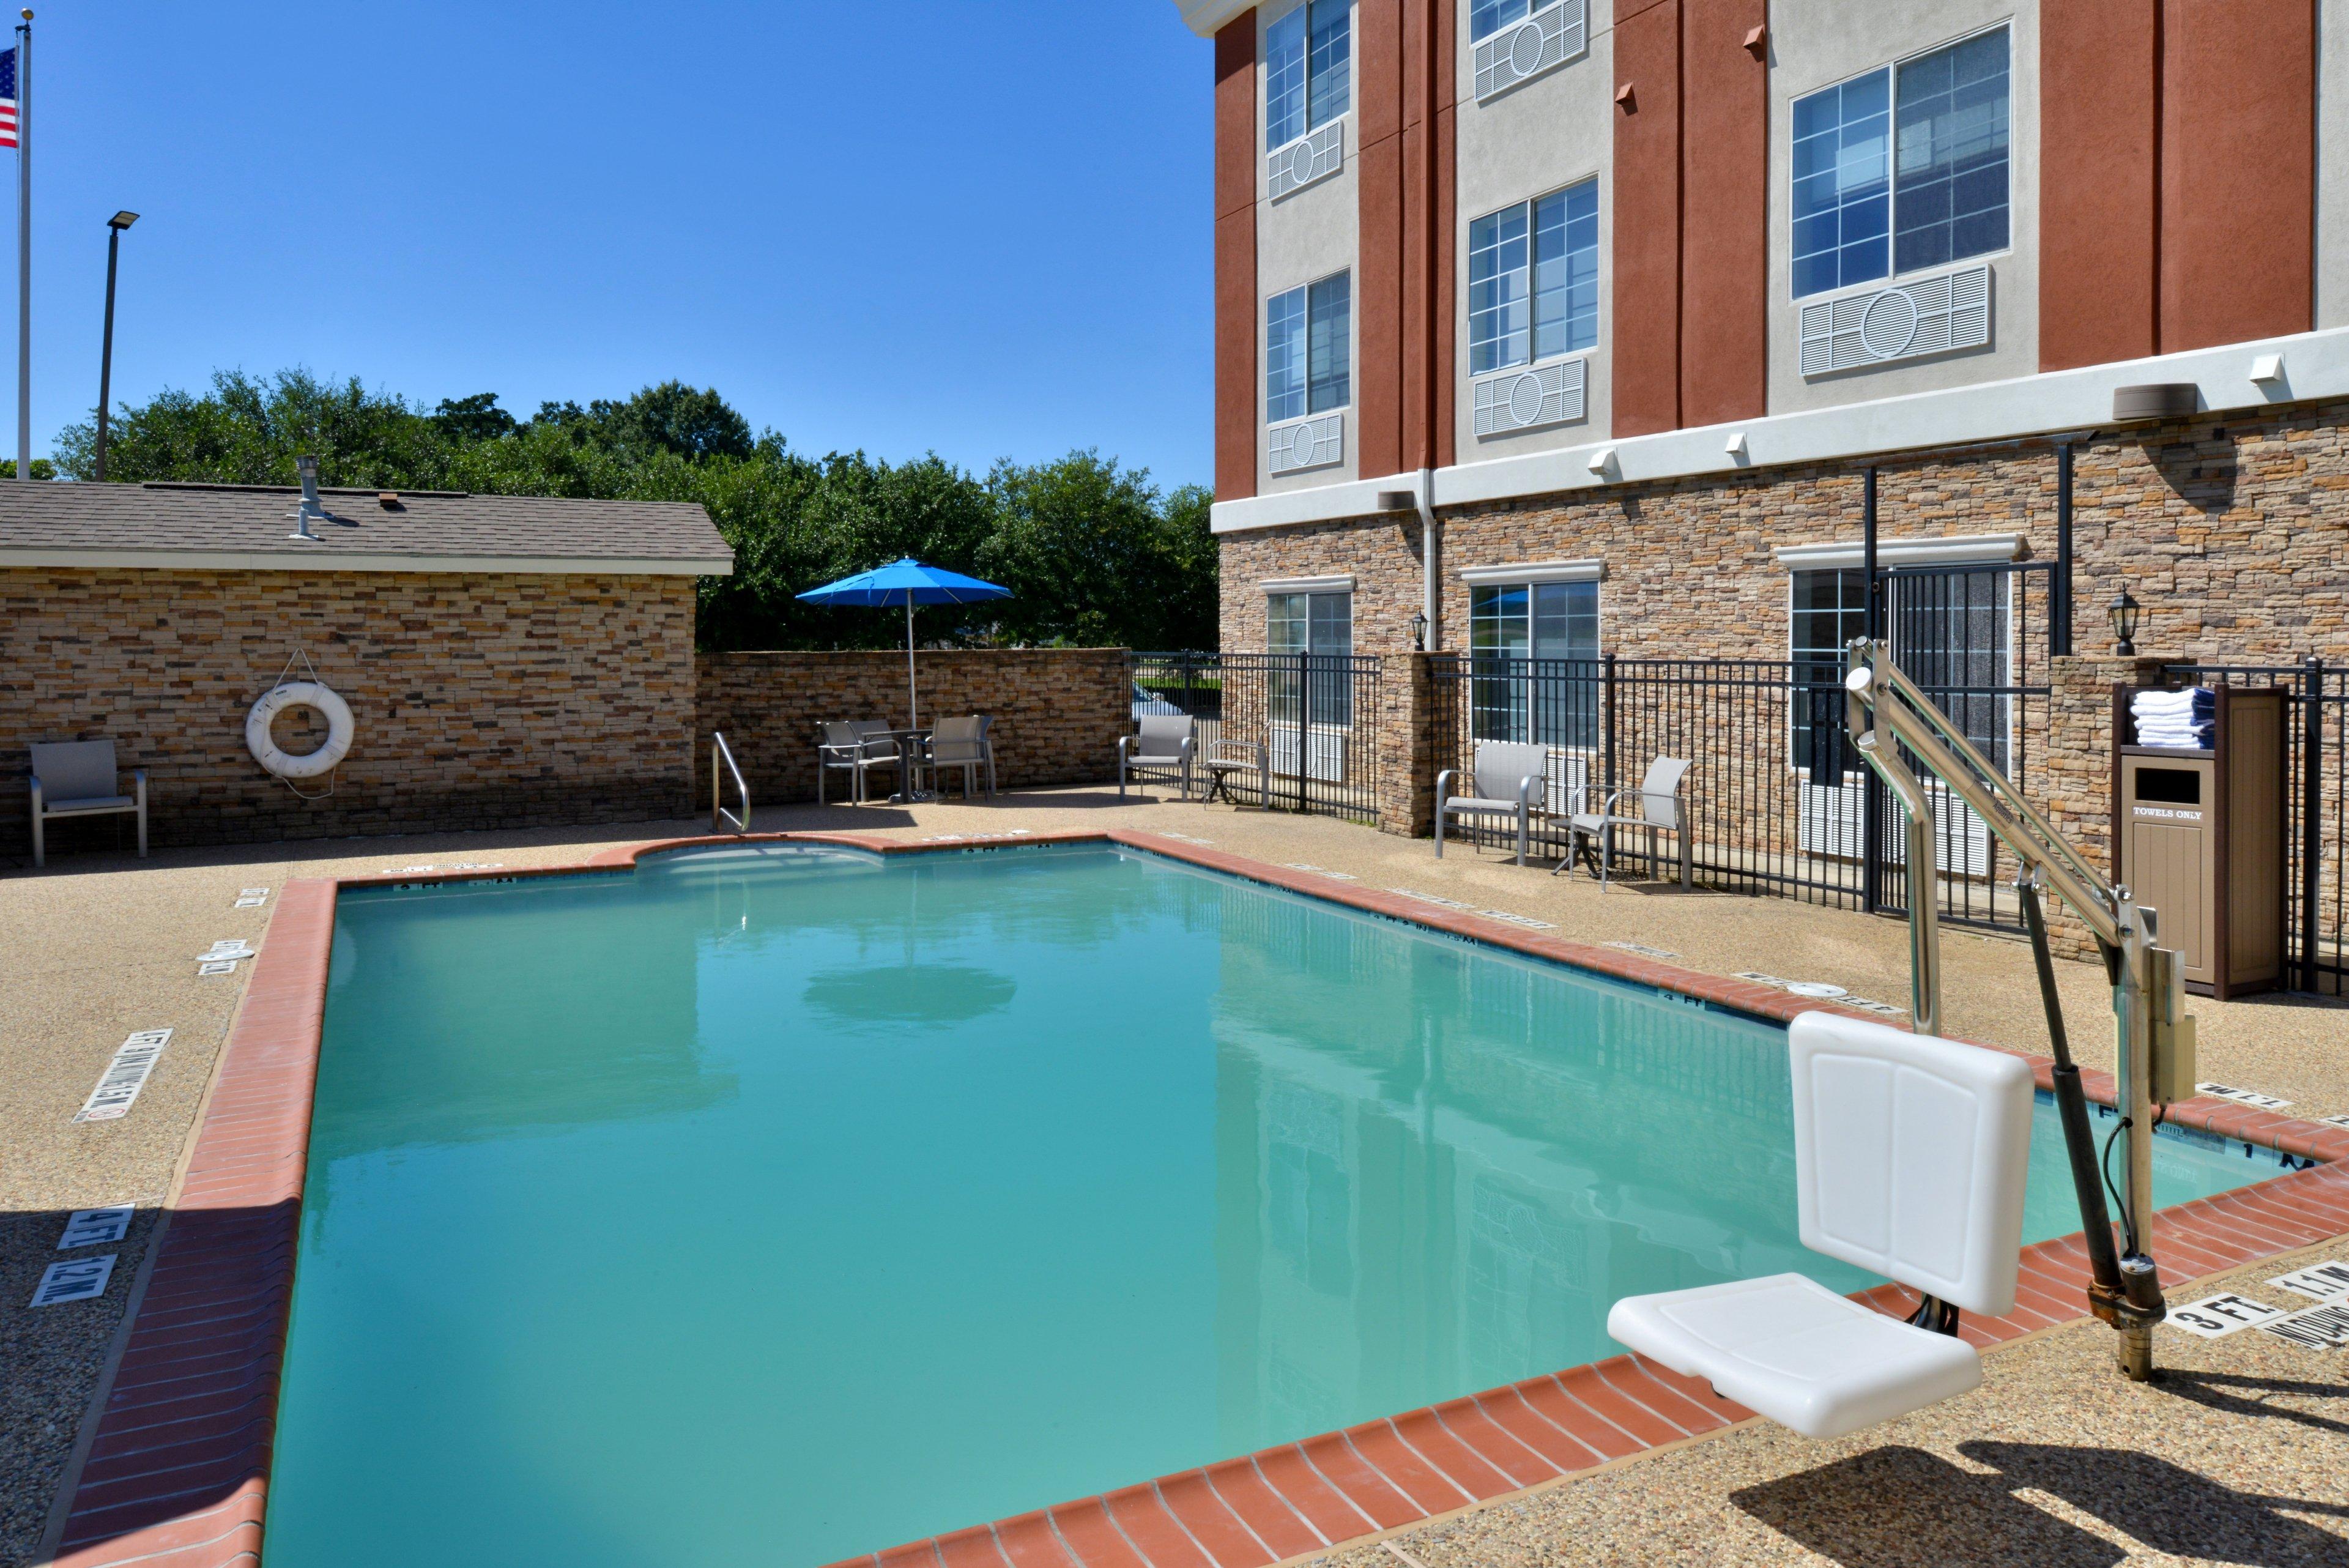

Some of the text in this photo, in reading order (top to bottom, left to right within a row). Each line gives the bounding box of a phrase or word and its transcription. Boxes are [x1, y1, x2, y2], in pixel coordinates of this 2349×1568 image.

[2133, 807, 2202, 819] TOWELS ONLY
[1416, 923, 1427, 932] IN
[1684, 995, 1702, 1007] FT
[128, 1037, 163, 1046] FT
[96, 1085, 135, 1098] 1.5
[2237, 1094, 2280, 1106] 1.1
[78, 1212, 124, 1224] 4
[51, 1258, 107, 1282] 1.2
[2282, 1274, 2346, 1296] 1.1
[2174, 1312, 2224, 1330] 3
